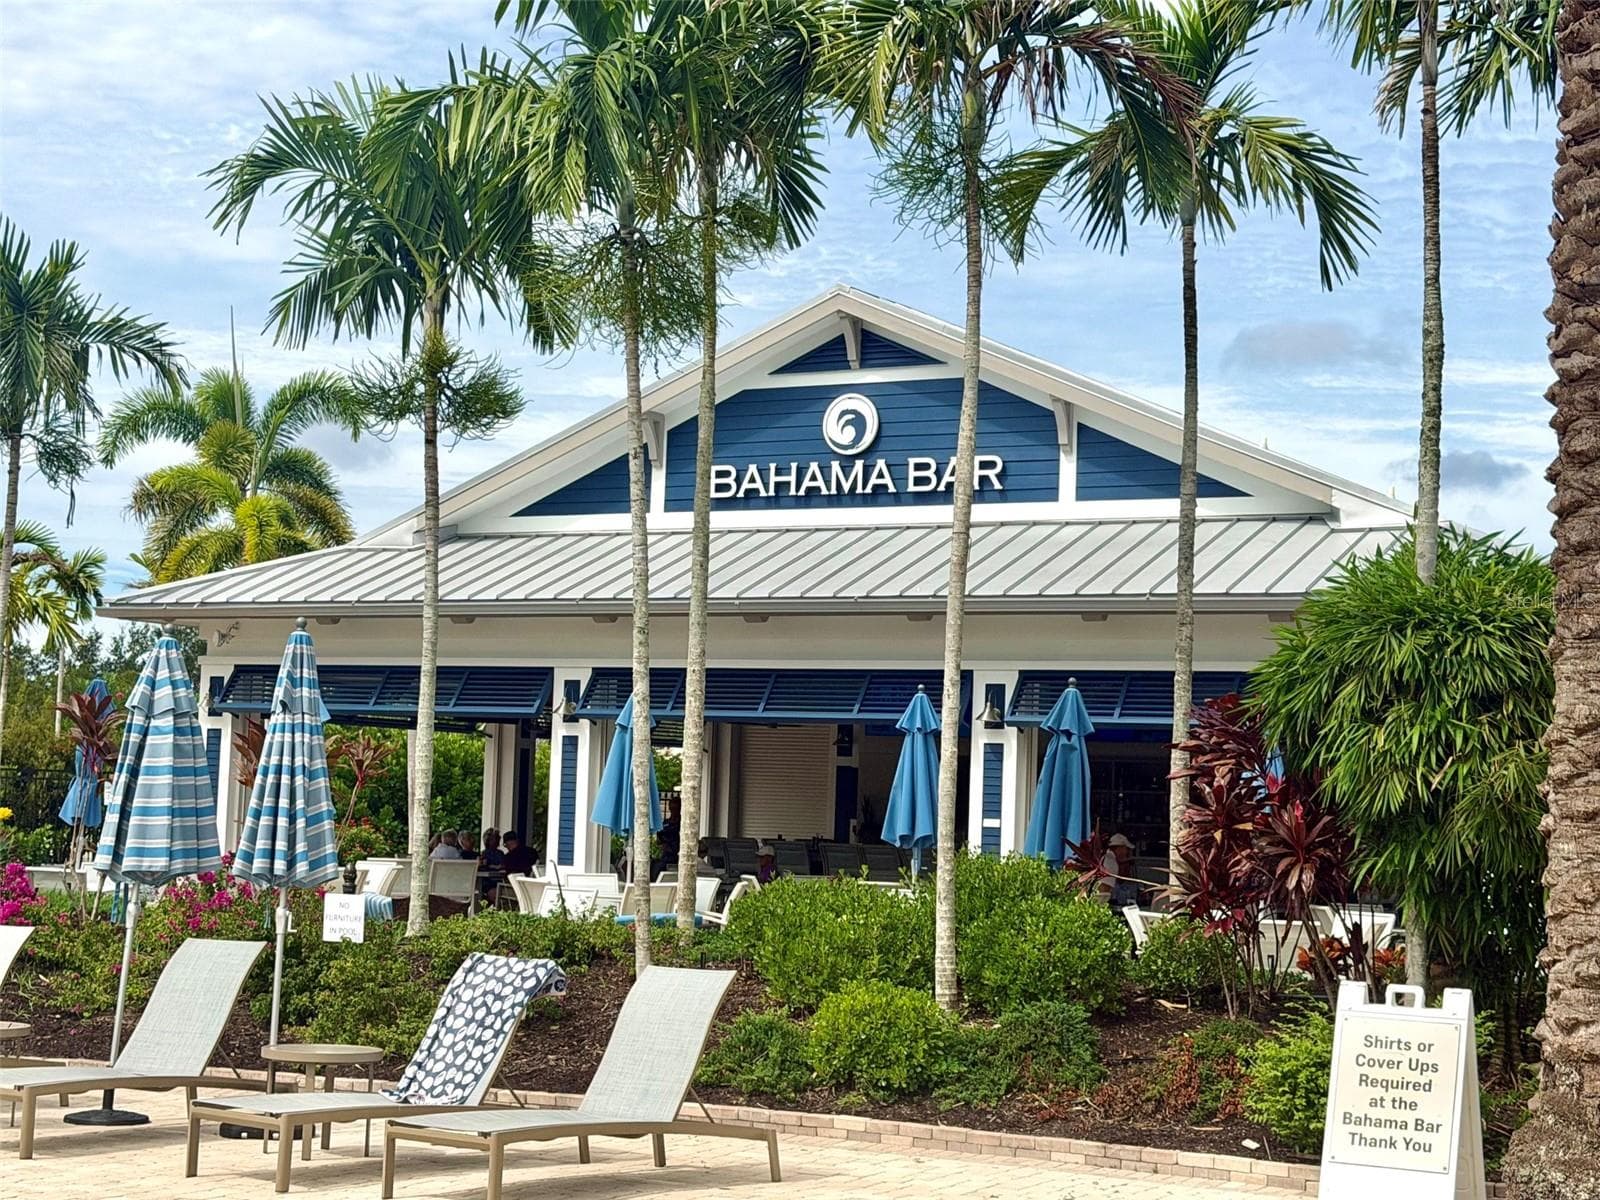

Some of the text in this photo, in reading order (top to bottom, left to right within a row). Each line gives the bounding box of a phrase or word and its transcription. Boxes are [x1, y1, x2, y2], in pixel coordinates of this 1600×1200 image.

[710, 459, 897, 498] BAHAMA
[339, 927, 357, 936] POOL
[1363, 1034, 1435, 1053] Shirts or
[1355, 1053, 1439, 1075] Cover Ups
[1358, 1073, 1432, 1093] Required
[1368, 1096, 1418, 1111] at the
[1342, 1111, 1443, 1133] Bahama Bar
[1348, 1131, 1432, 1153] Thank You
